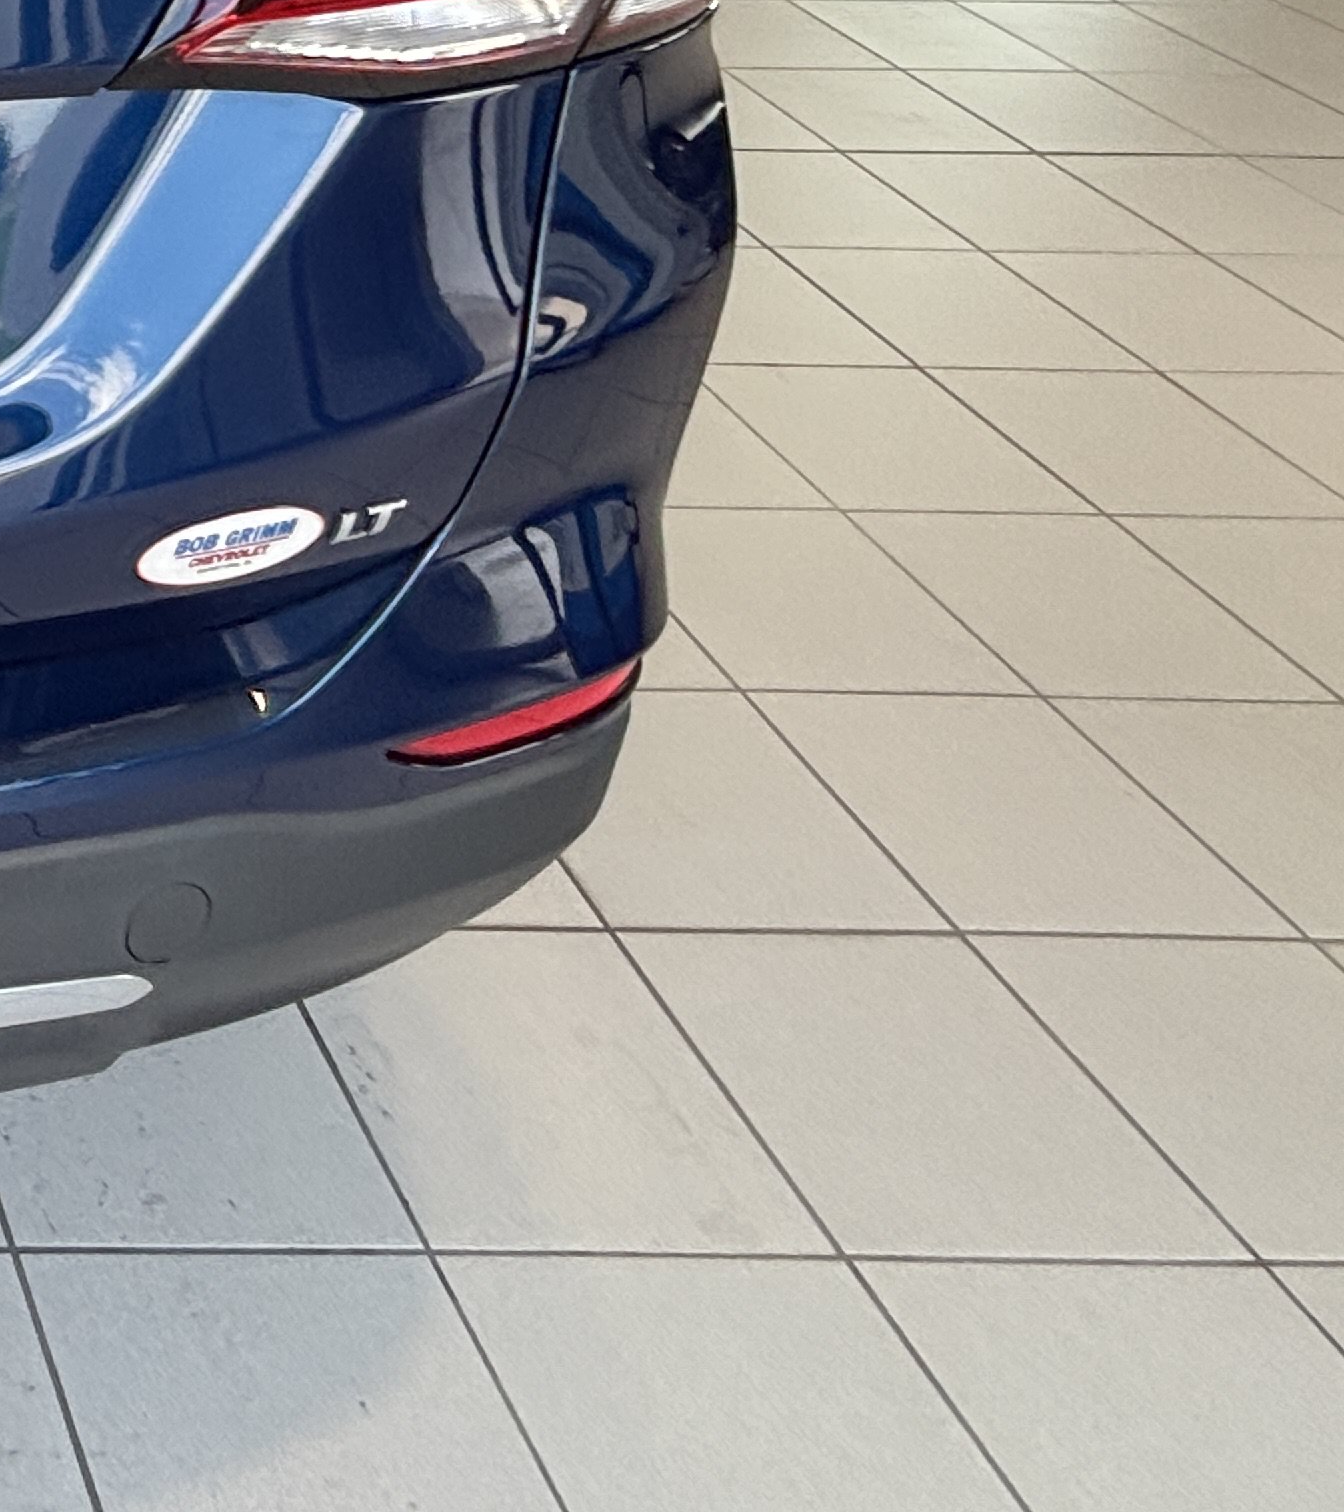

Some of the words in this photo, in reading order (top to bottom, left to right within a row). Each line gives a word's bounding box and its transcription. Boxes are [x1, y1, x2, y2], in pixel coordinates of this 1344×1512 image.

[174, 533, 221, 556] BOB
[225, 518, 299, 546] GRIMM
[329, 497, 409, 546] LT
